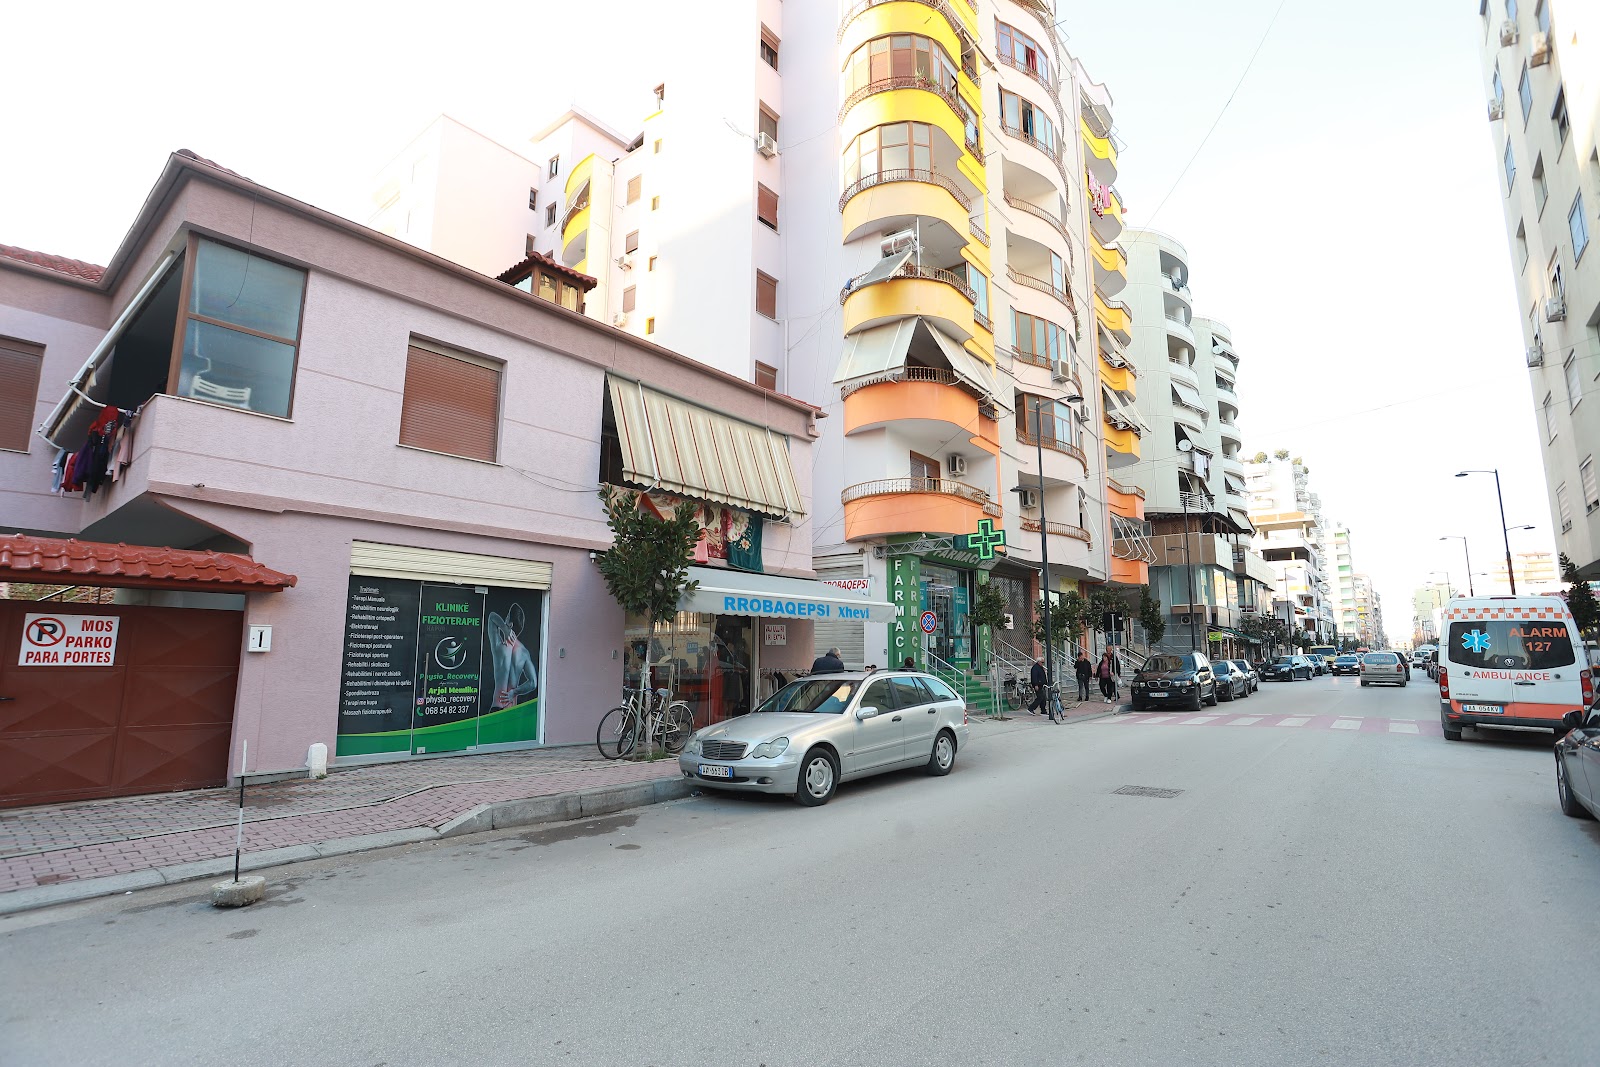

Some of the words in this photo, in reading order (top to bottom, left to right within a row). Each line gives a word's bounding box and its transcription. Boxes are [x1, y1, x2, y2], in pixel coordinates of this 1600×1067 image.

[435, 602, 470, 613] KLINIKË
[724, 596, 830, 617] RROBAQEPSI
[838, 606, 870, 619] Xhevi
[894, 559, 904, 663] FARMACI
[910, 560, 918, 663] FARMACI
[81, 619, 114, 632] MOS
[422, 615, 481, 626] FIZIOTERAPIE
[1509, 627, 1567, 638] ALARM
[65, 636, 113, 648] PARKO
[1525, 641, 1552, 652] 127
[25, 651, 59, 663] PARA
[63, 651, 111, 663] PORTES
[1472, 671, 1551, 681] AMBULANCE
[428, 686, 447, 695] Arjol
[425, 694, 477, 705] physio_recovery
[425, 706, 438, 715] 068
[439, 706, 448, 714] 54
[448, 706, 457, 714] 82
[457, 705, 470, 713] 337
